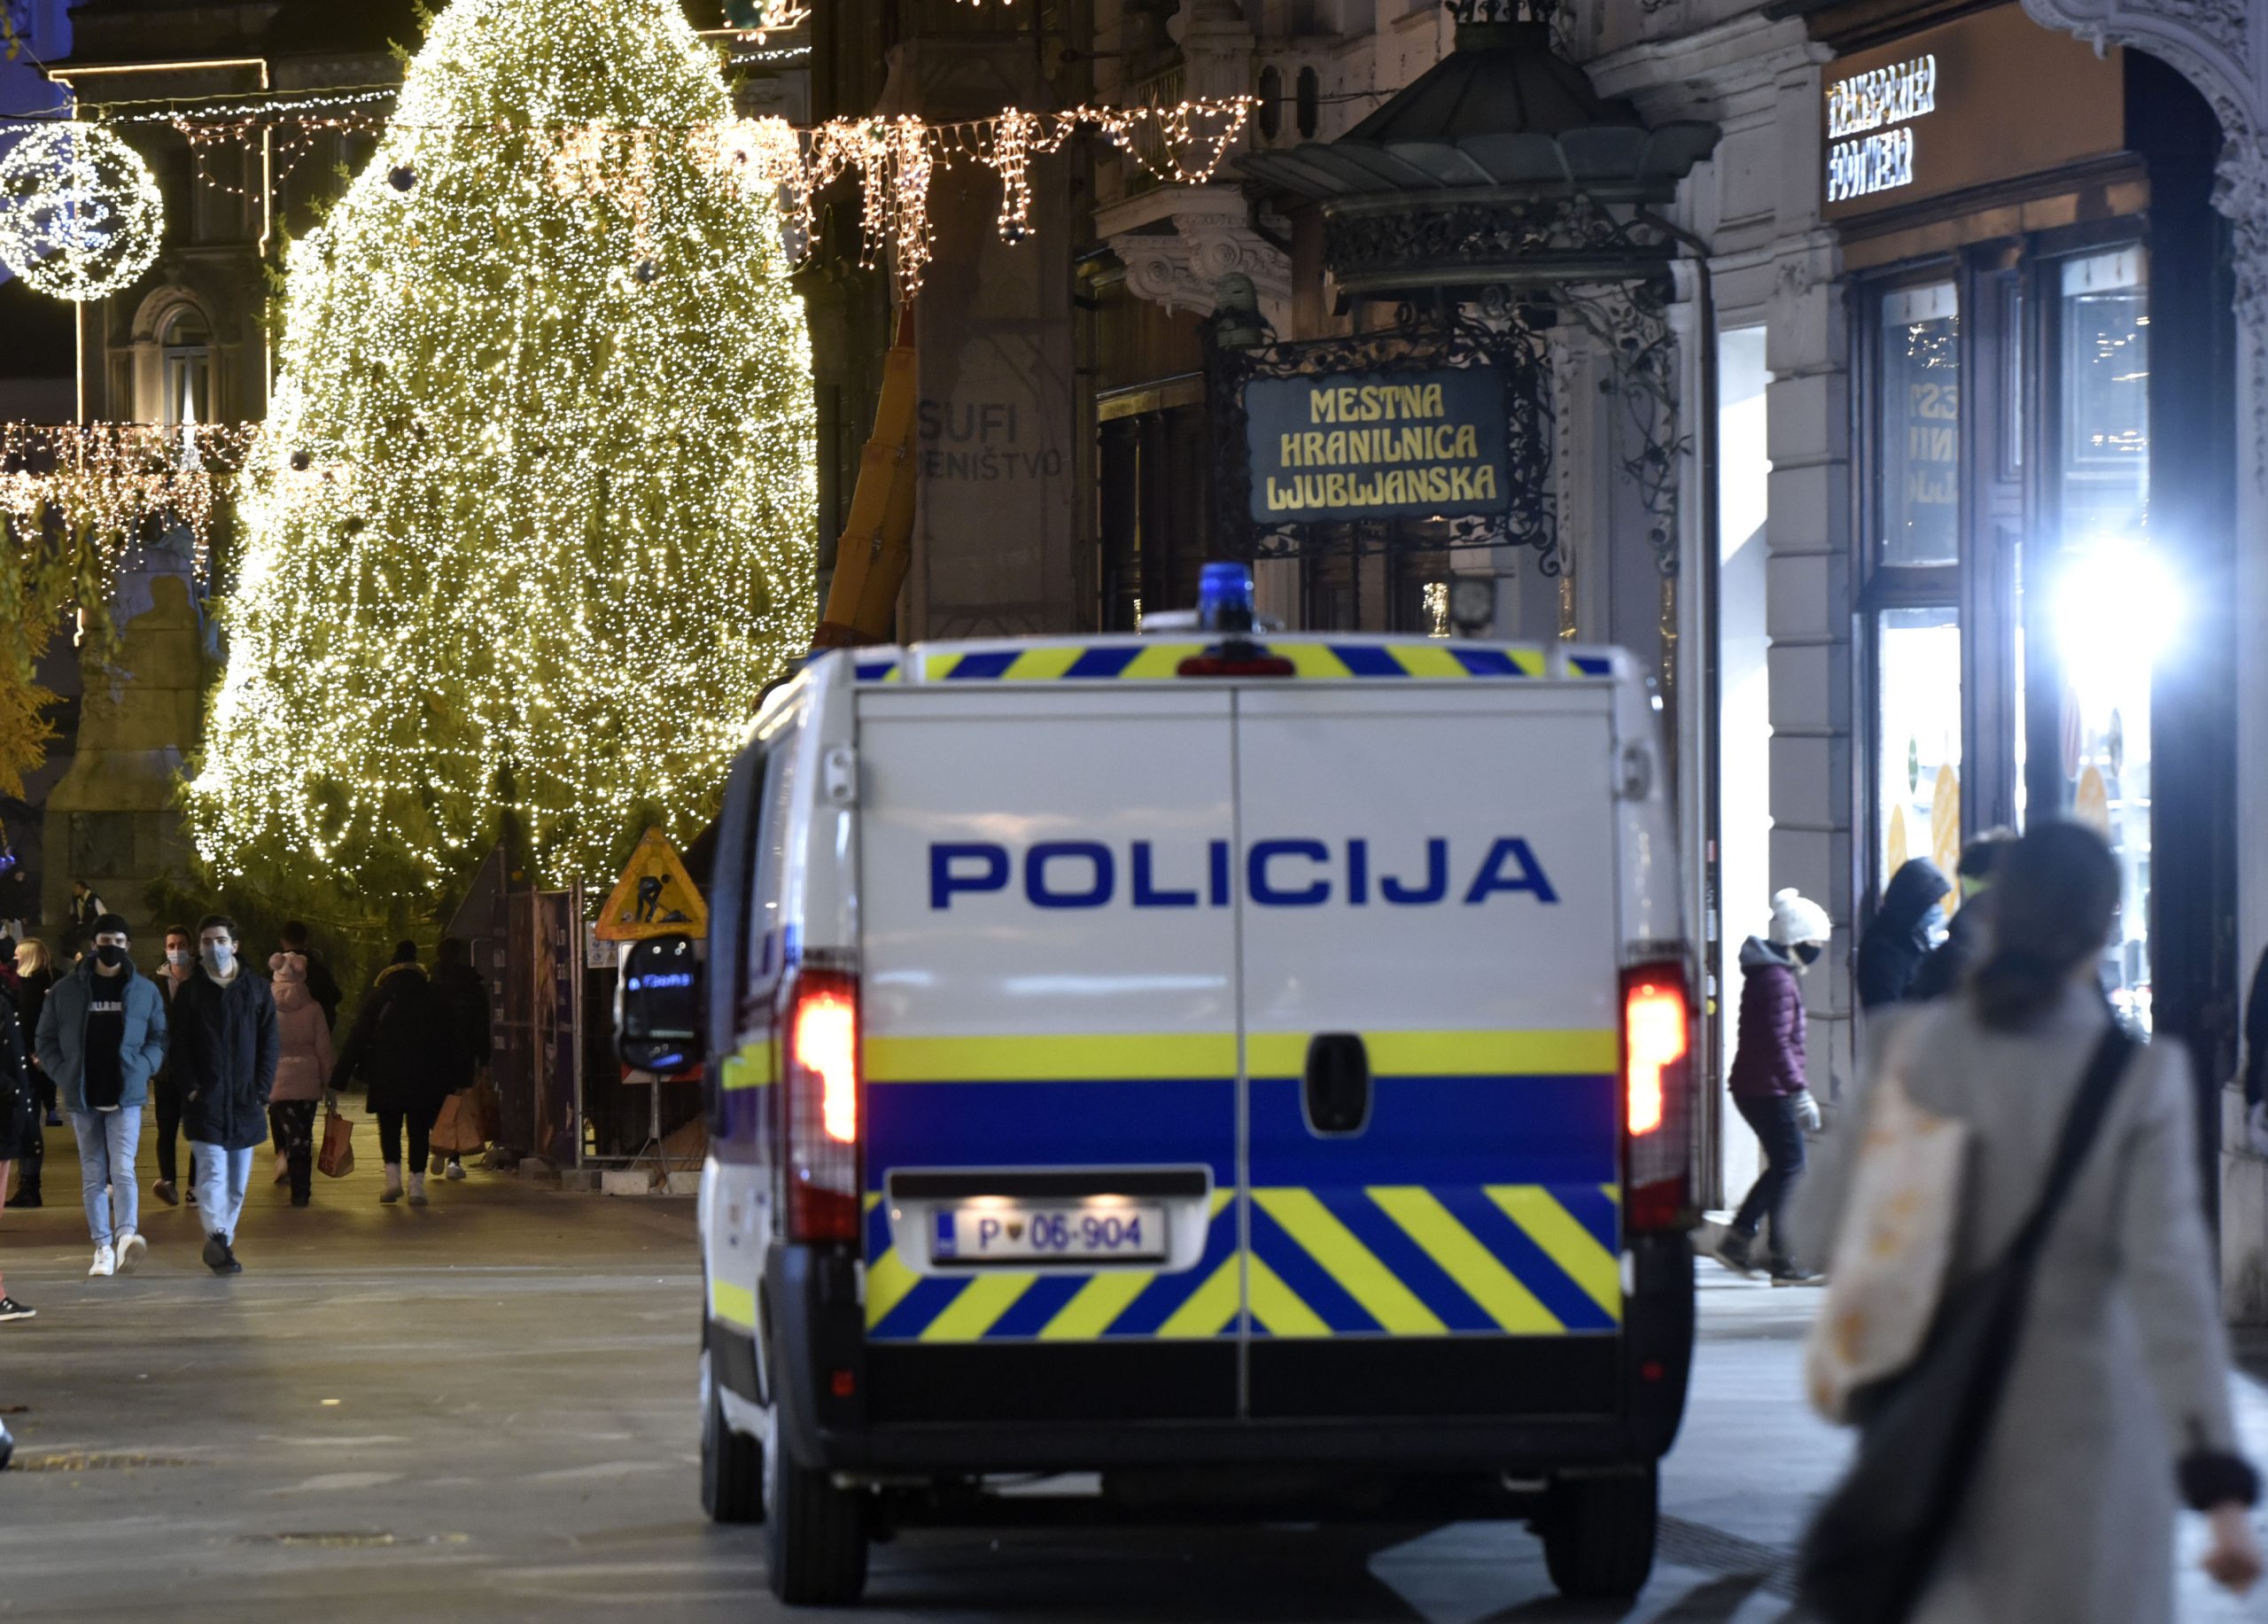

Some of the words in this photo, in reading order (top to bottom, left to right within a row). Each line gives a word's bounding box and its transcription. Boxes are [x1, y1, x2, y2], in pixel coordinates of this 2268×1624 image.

[1310, 383, 1445, 423] MESTNA
[1280, 423, 1479, 468] HRANILNICA
[1266, 464, 1497, 511] LJUBLJANSKA
[928, 836, 1561, 911] POLICIJA
[979, 1218, 999, 1250] P
[1029, 1212, 1141, 1249] 06-904
